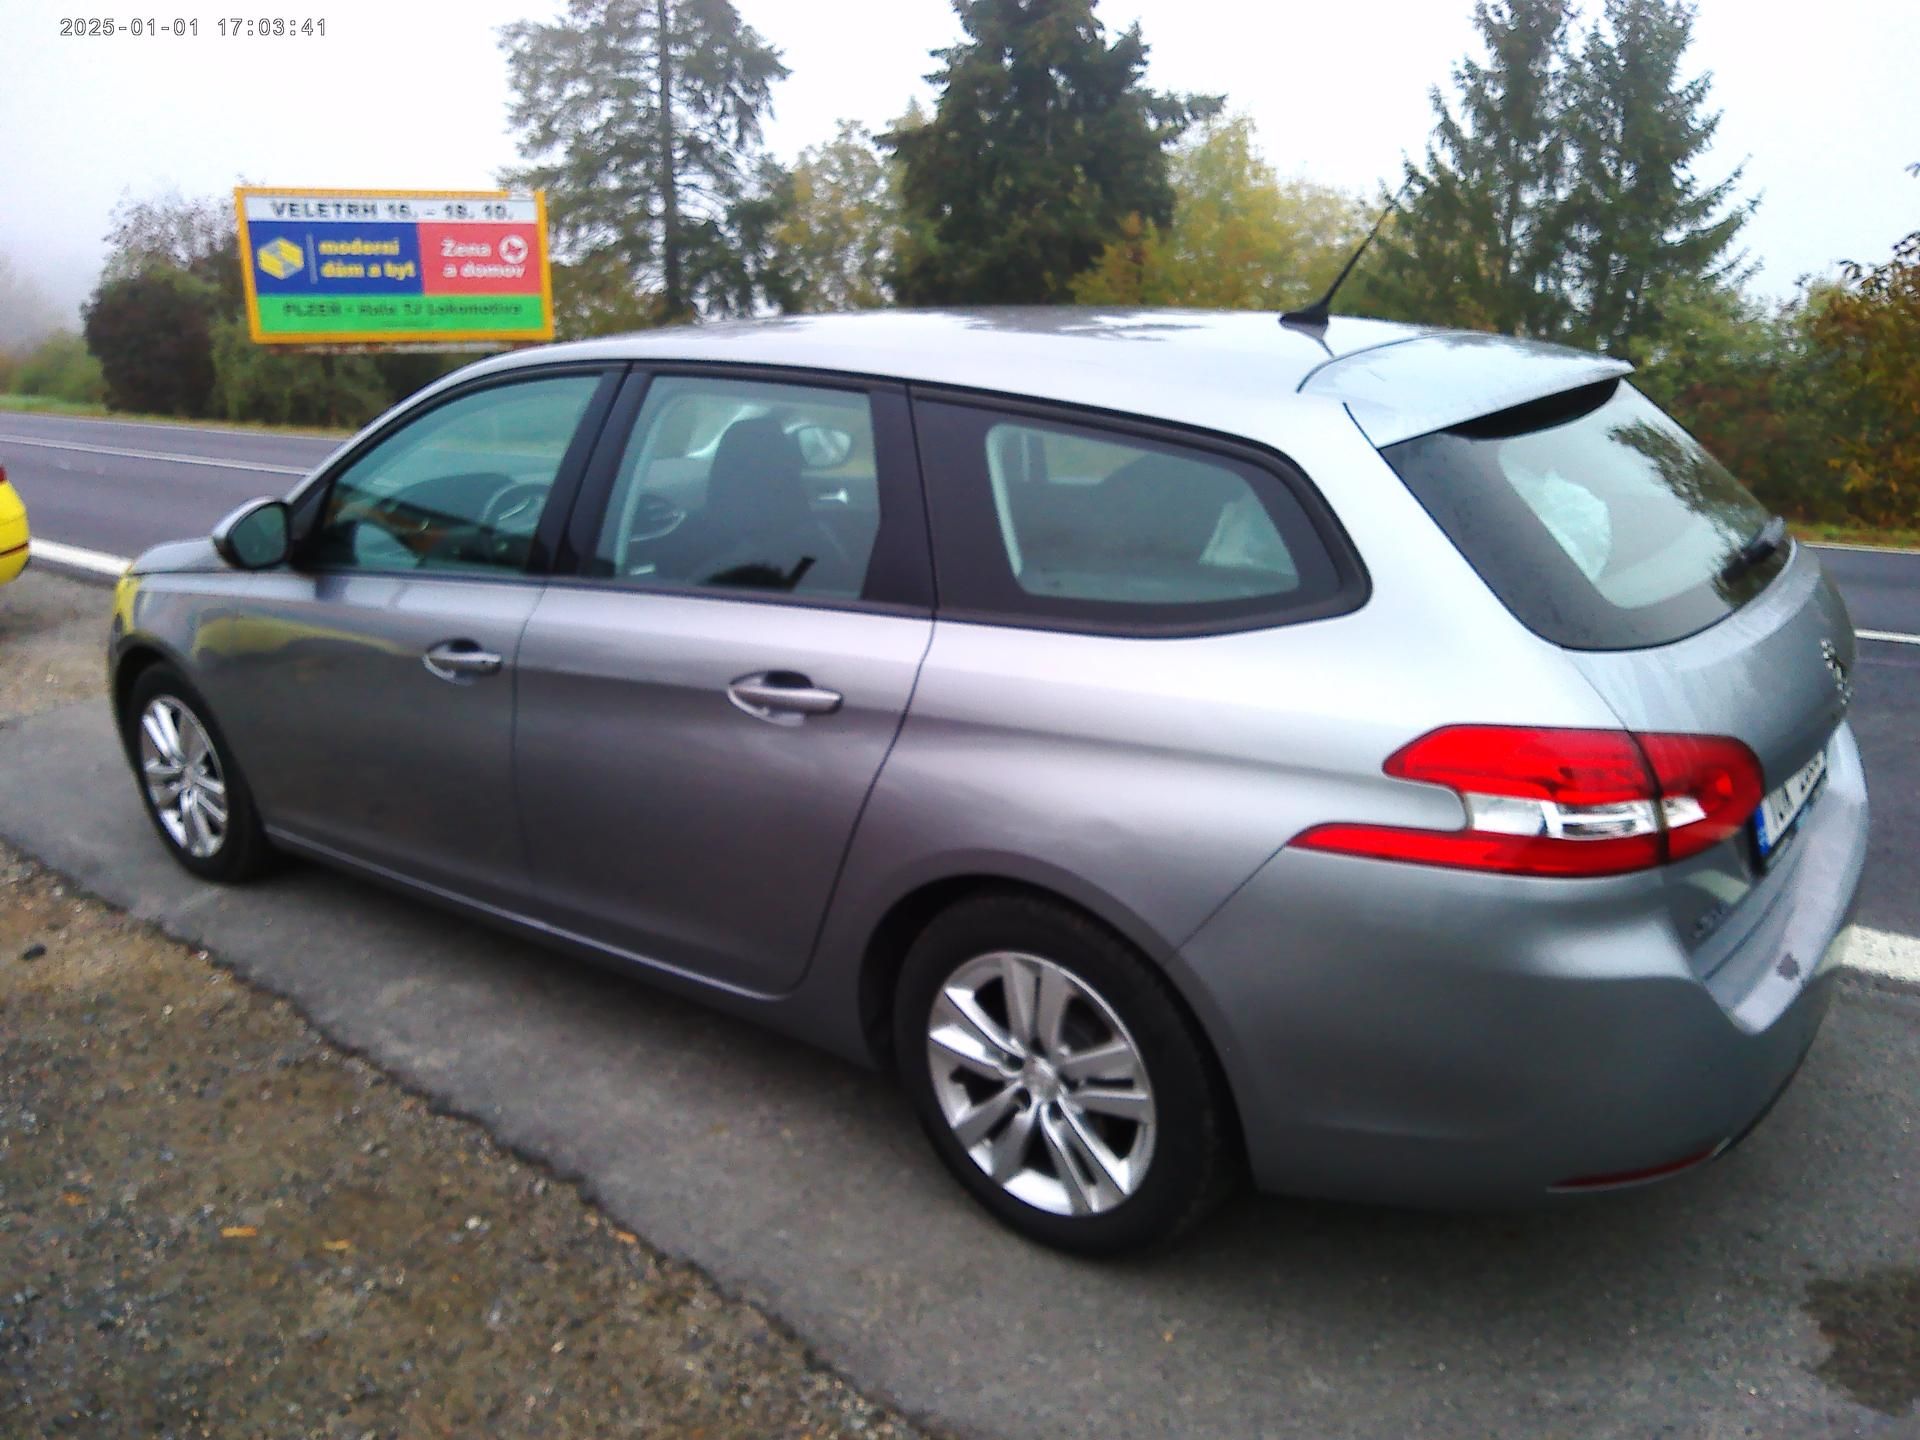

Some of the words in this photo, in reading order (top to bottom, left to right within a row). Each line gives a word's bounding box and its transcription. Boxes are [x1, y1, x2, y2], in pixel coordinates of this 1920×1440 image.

[270, 200, 378, 218] VELETRH
[367, 264, 381, 278] a
[383, 261, 416, 281] byt
[442, 264, 457, 278] a
